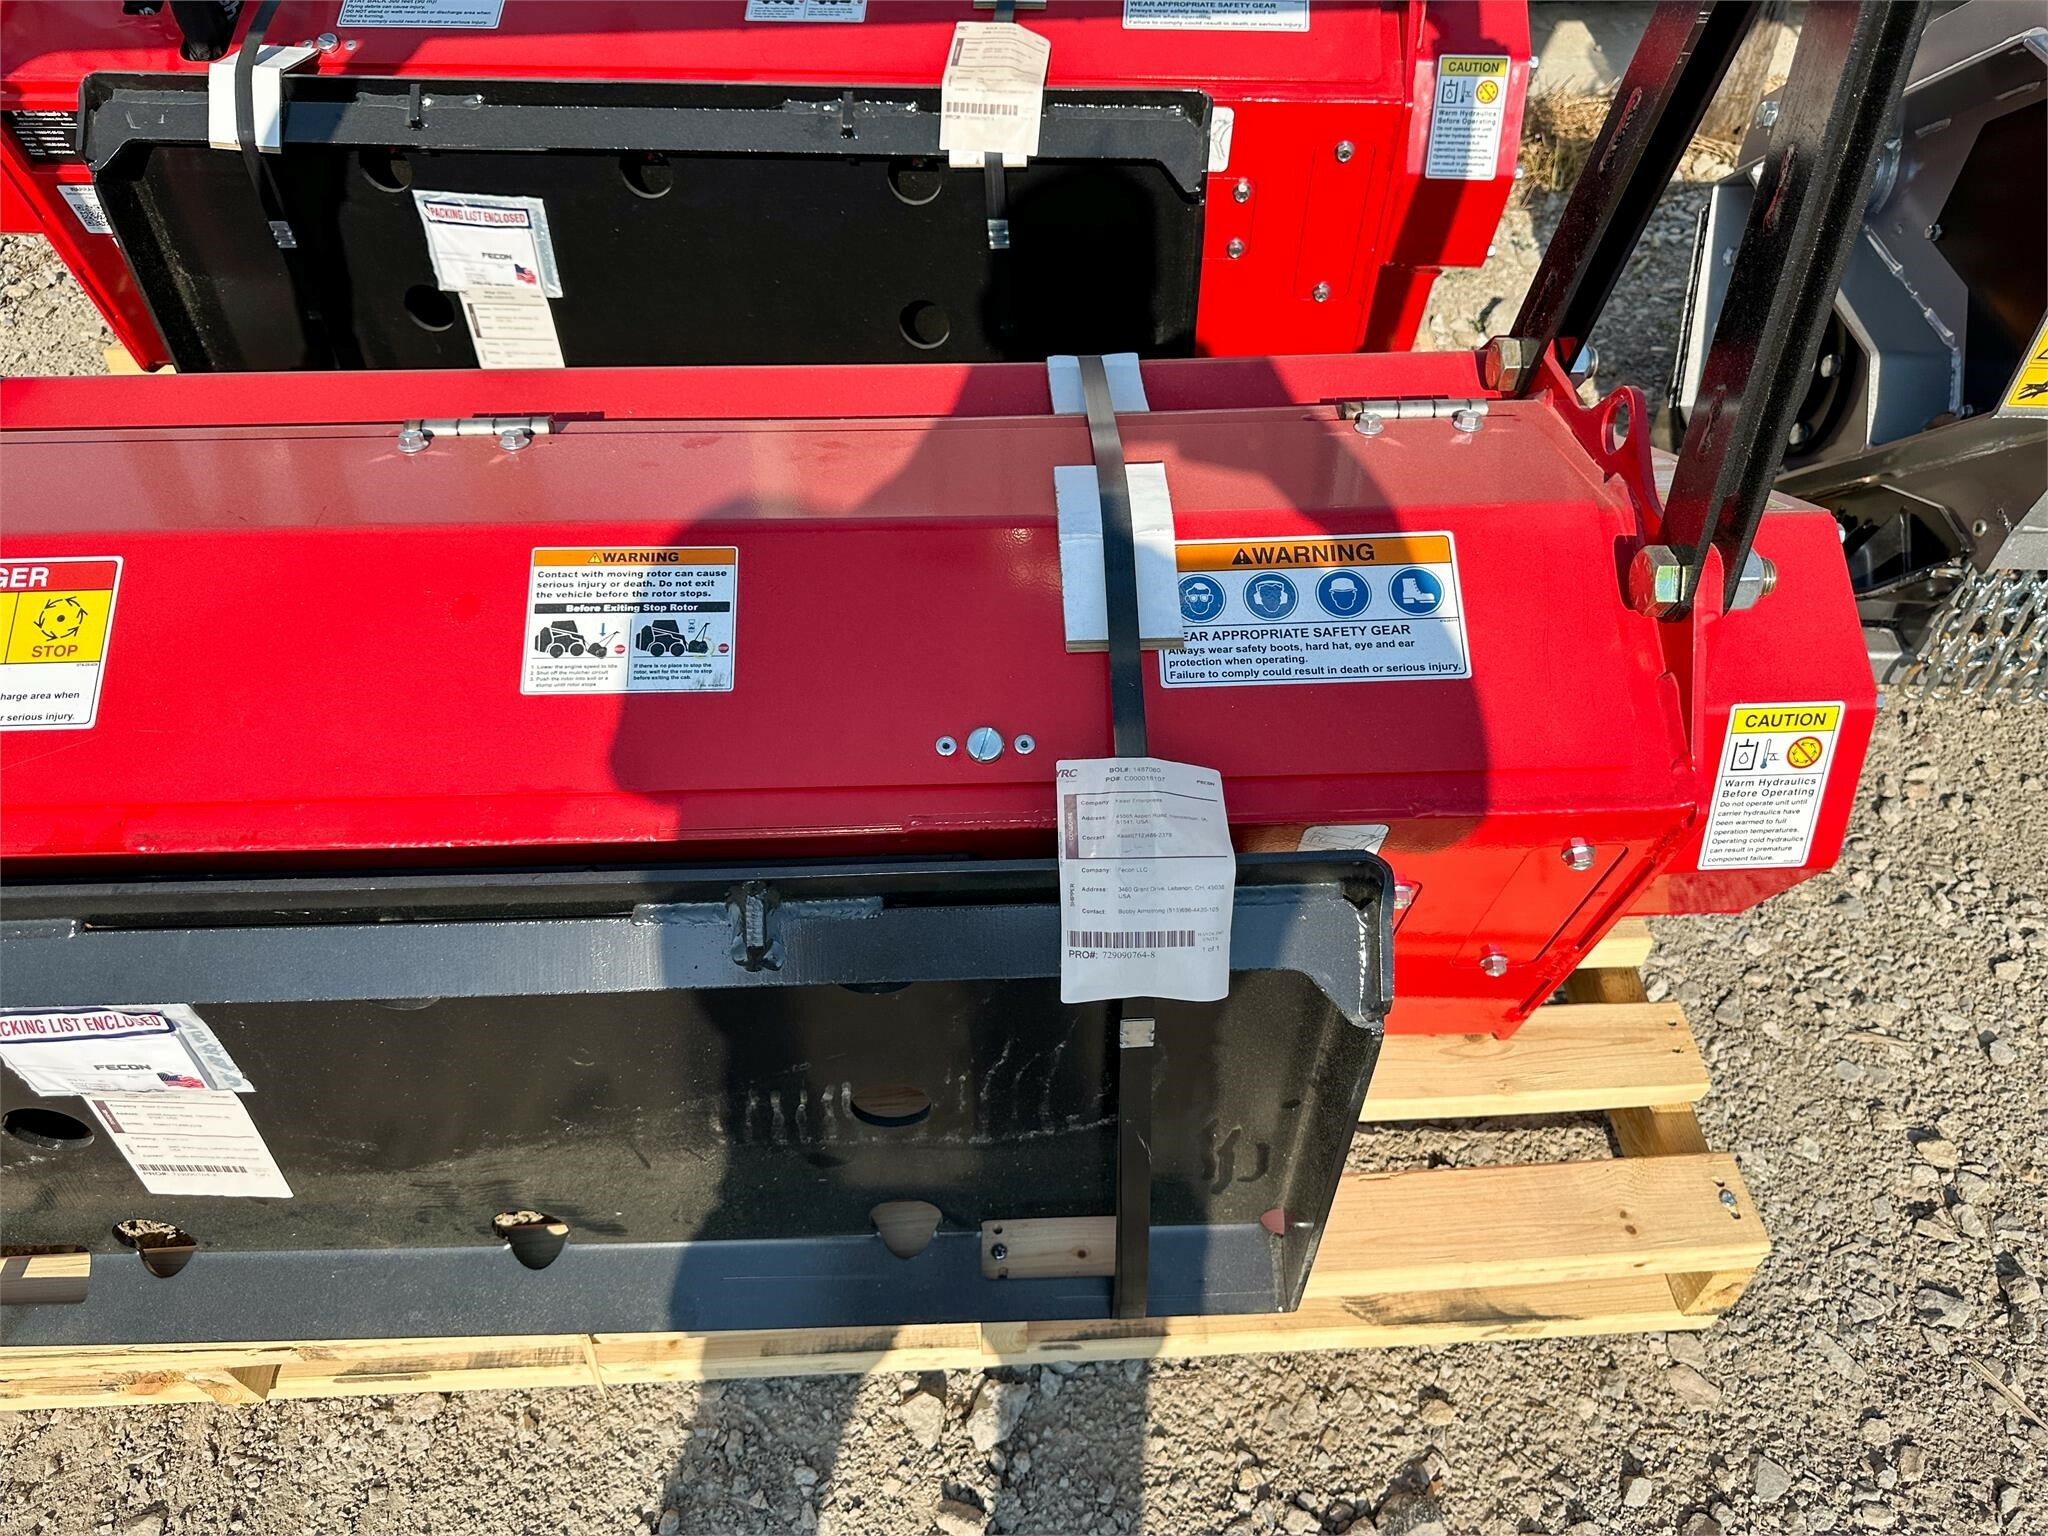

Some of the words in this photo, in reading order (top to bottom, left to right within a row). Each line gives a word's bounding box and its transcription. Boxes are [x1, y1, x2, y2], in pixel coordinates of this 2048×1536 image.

[1448, 62, 1500, 72] CAUTION
[430, 207, 464, 219] PACKING
[464, 209, 482, 221] LIST
[484, 212, 526, 224] ENCLOSED
[603, 552, 680, 563] WARNING
[1251, 543, 1375, 565] WARNING
[578, 581, 606, 589] injury
[680, 590, 712, 598] stops.
[566, 604, 601, 612] Before
[603, 604, 640, 613] Exiting
[642, 604, 667, 612] Stop
[670, 604, 698, 612] Rotor
[1184, 632, 1208, 642] EAR
[1212, 628, 1310, 641] APPROPRIATE
[1313, 626, 1367, 638] SAFETY
[1371, 624, 1411, 636] GEAR
[32, 644, 78, 658] STOP
[1168, 647, 1206, 656] Always
[1236, 644, 1267, 654] safety
[1270, 643, 1302, 652] boots,
[1306, 642, 1330, 650] hard
[1332, 641, 1352, 651] hat,
[1354, 642, 1373, 650] eye
[1376, 640, 1396, 648] and
[1169, 657, 1222, 668] protection
[1224, 656, 1253, 666] when
[1256, 655, 1308, 666] operating.
[1170, 670, 1206, 680] Failure
[1222, 668, 1260, 679] comply
[1262, 668, 1292, 676] could
[1294, 666, 1326, 676] result
[1328, 666, 1338, 674] in
[1340, 665, 1370, 674] death
[1386, 663, 1426, 672] serious
[1428, 662, 1462, 672] injury.
[0, 693, 28, 702] harge
[7, 713, 42, 722] serious
[46, 712, 75, 722] injury.
[1745, 713, 1826, 728] CAUTION
[1724, 780, 1755, 788] Warm
[1758, 778, 1816, 788] Hydraulics
[1722, 790, 1758, 798] Before
[1762, 788, 1815, 798] Operating
[1744, 809, 1781, 817] hydraulics
[1068, 950, 1098, 960] PRO#:
[1103, 951, 1156, 959] 729090764-8
[0, 1018, 46, 1038] CKING
[50, 1017, 82, 1034] LIST
[84, 1014, 162, 1031] ENCLOSED
[94, 1064, 152, 1072] FECON
